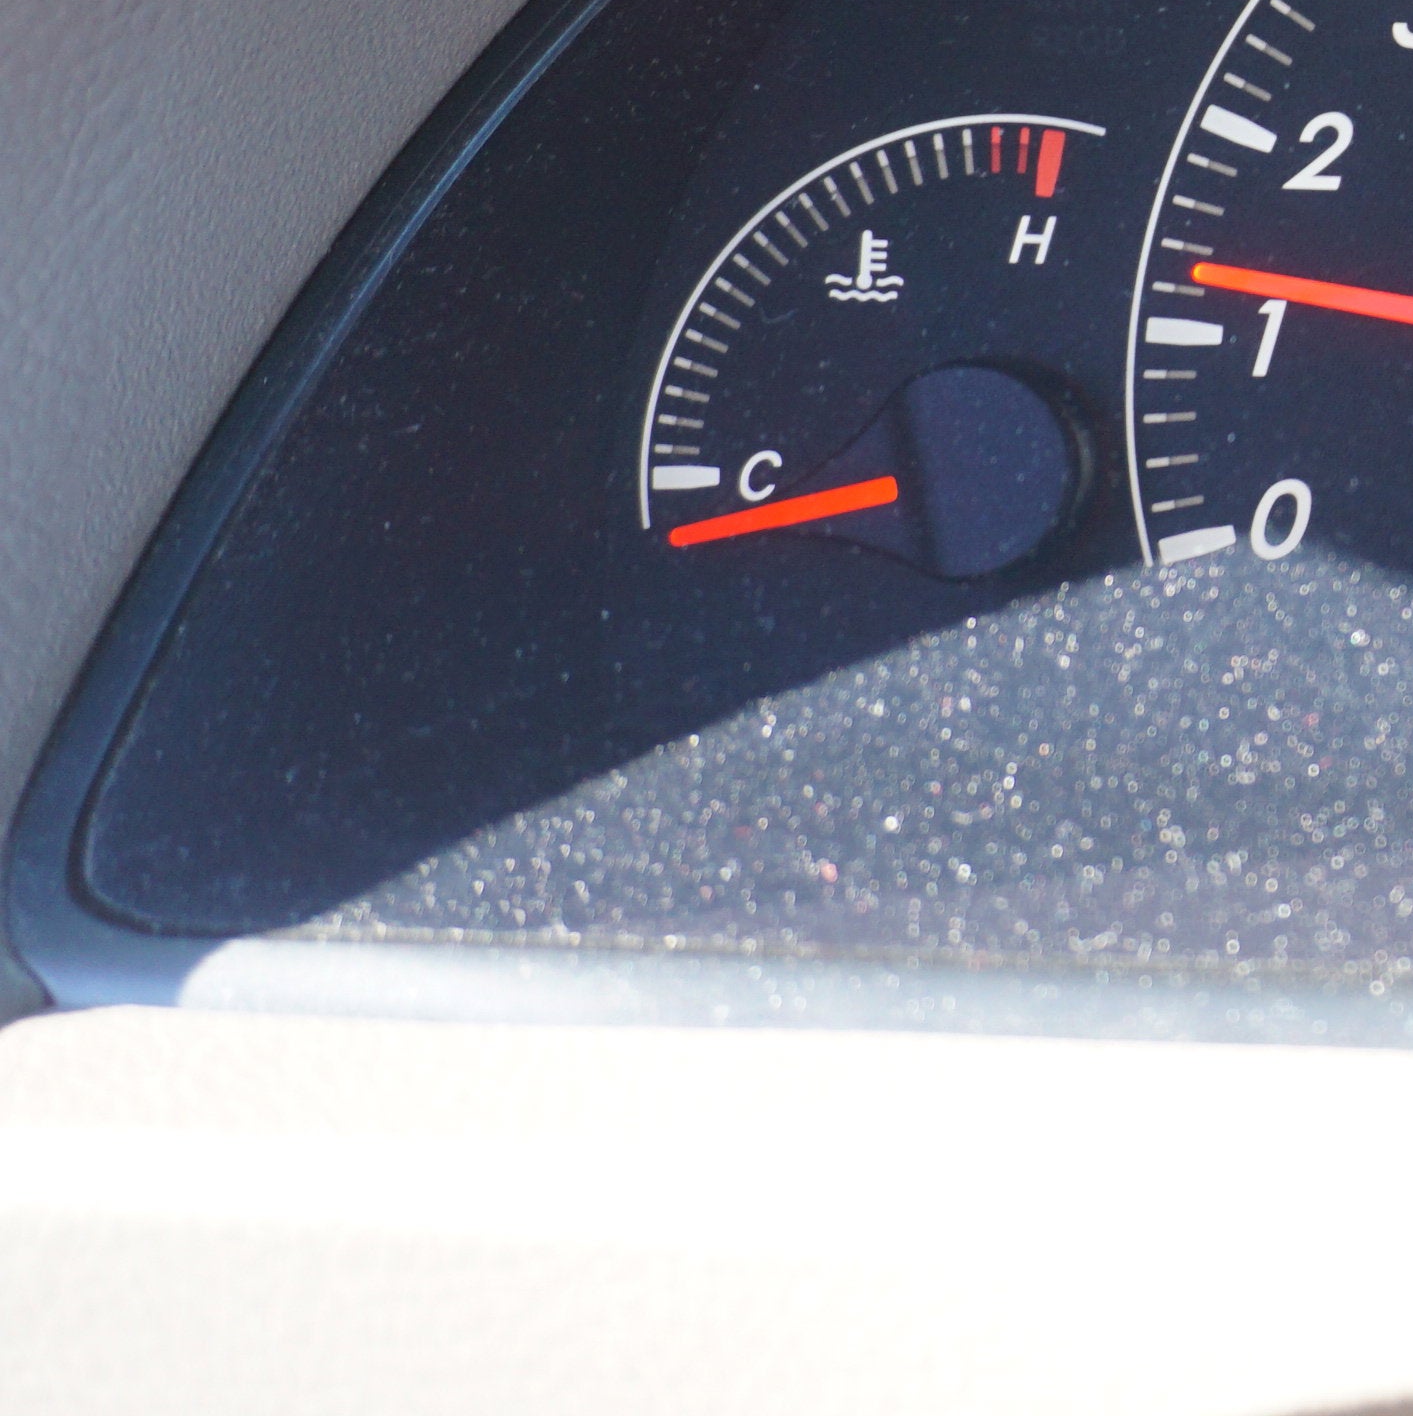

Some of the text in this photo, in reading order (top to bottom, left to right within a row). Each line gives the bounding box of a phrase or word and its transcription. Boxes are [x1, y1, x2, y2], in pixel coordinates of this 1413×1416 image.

[1282, 111, 1354, 191] 2
[1008, 215, 1057, 265] H
[1252, 299, 1288, 378] 1
[738, 450, 783, 502] C
[1249, 478, 1312, 561] 0
